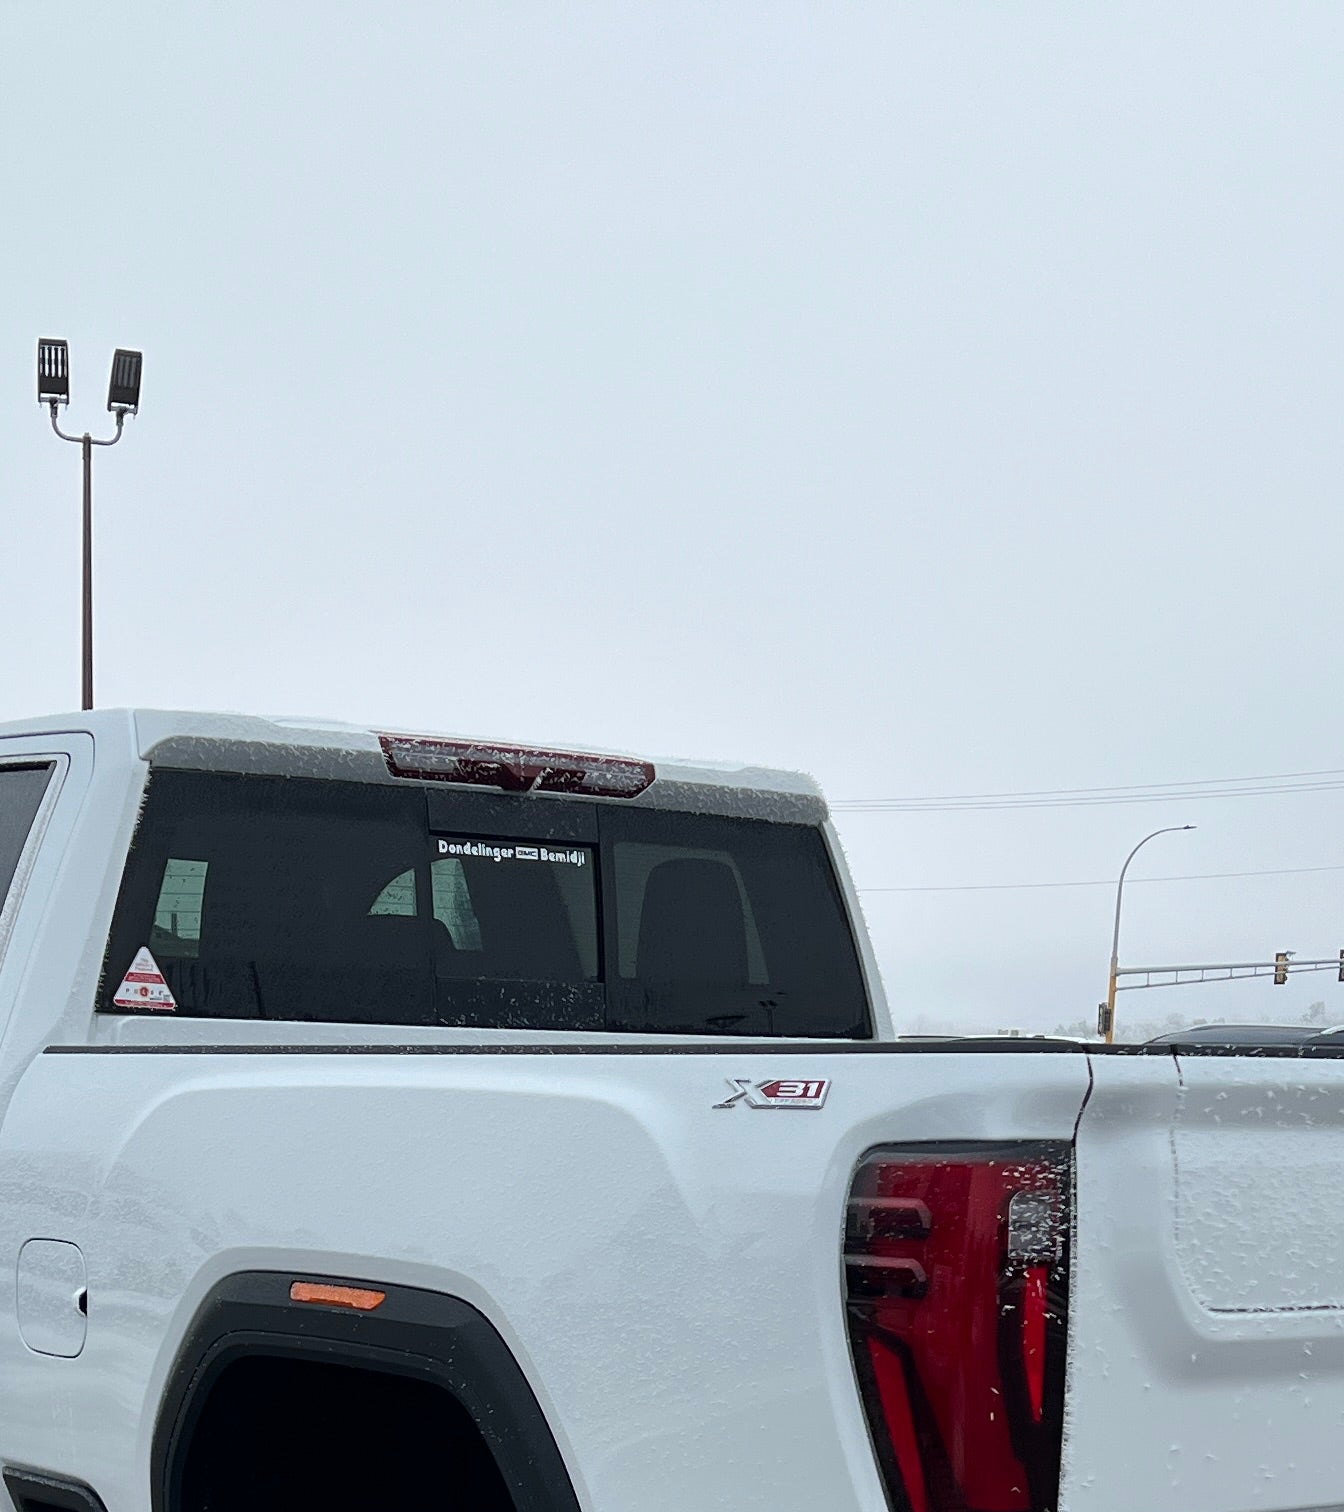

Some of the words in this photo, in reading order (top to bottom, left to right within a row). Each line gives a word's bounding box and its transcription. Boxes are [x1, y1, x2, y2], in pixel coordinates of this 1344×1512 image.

[438, 839, 514, 862] Dondelinger
[516, 848, 538, 859] GMC
[540, 848, 586, 867] Bemidji
